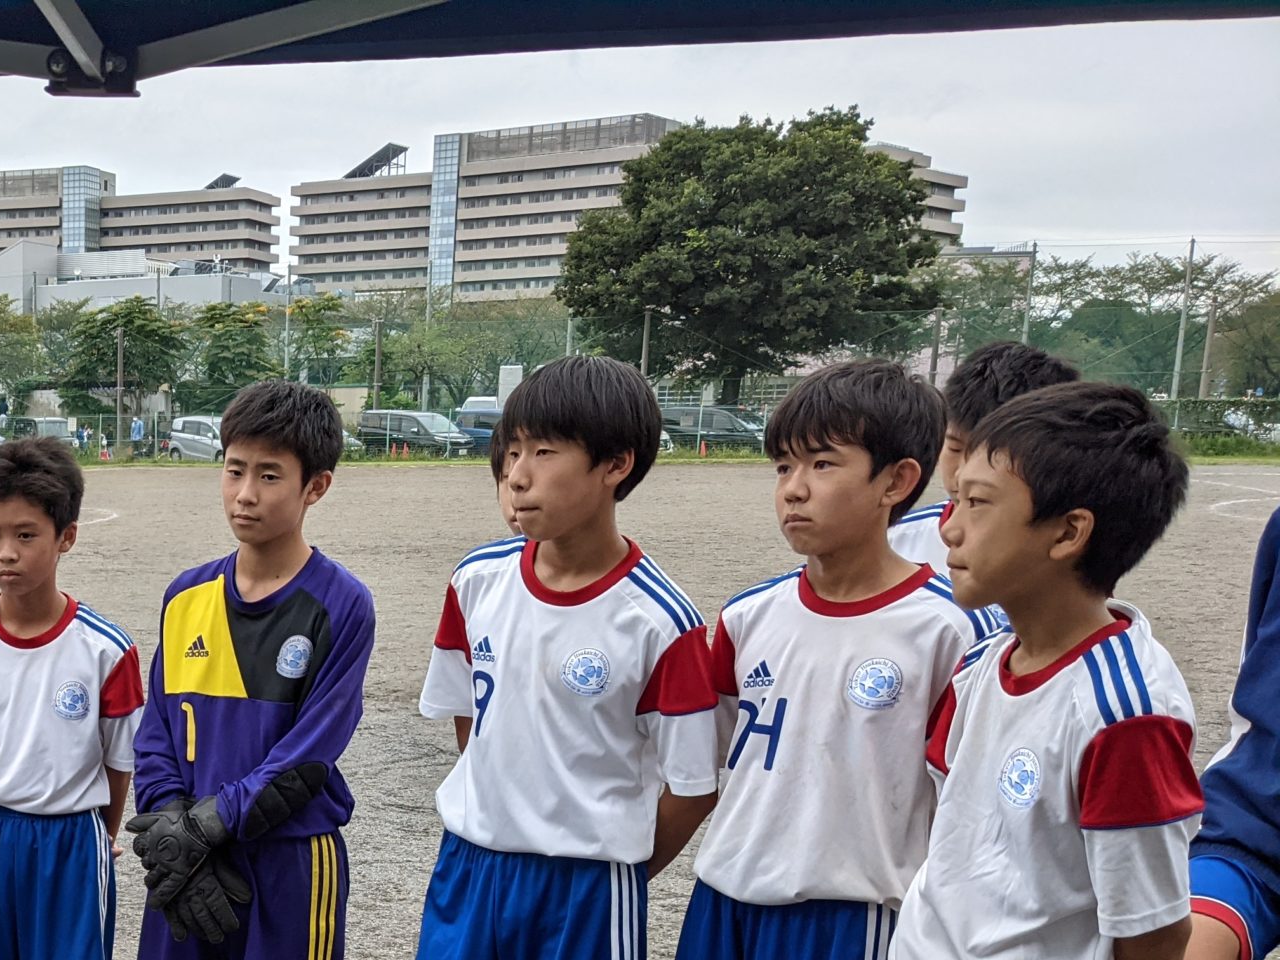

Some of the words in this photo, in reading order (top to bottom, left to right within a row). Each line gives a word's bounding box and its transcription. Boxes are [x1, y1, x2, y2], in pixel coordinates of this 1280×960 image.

[184, 650, 209, 658] adidas
[472, 652, 496, 663] adidas
[743, 676, 775, 689] adidas
[472, 670, 495, 738] 9
[181, 701, 196, 762] 1
